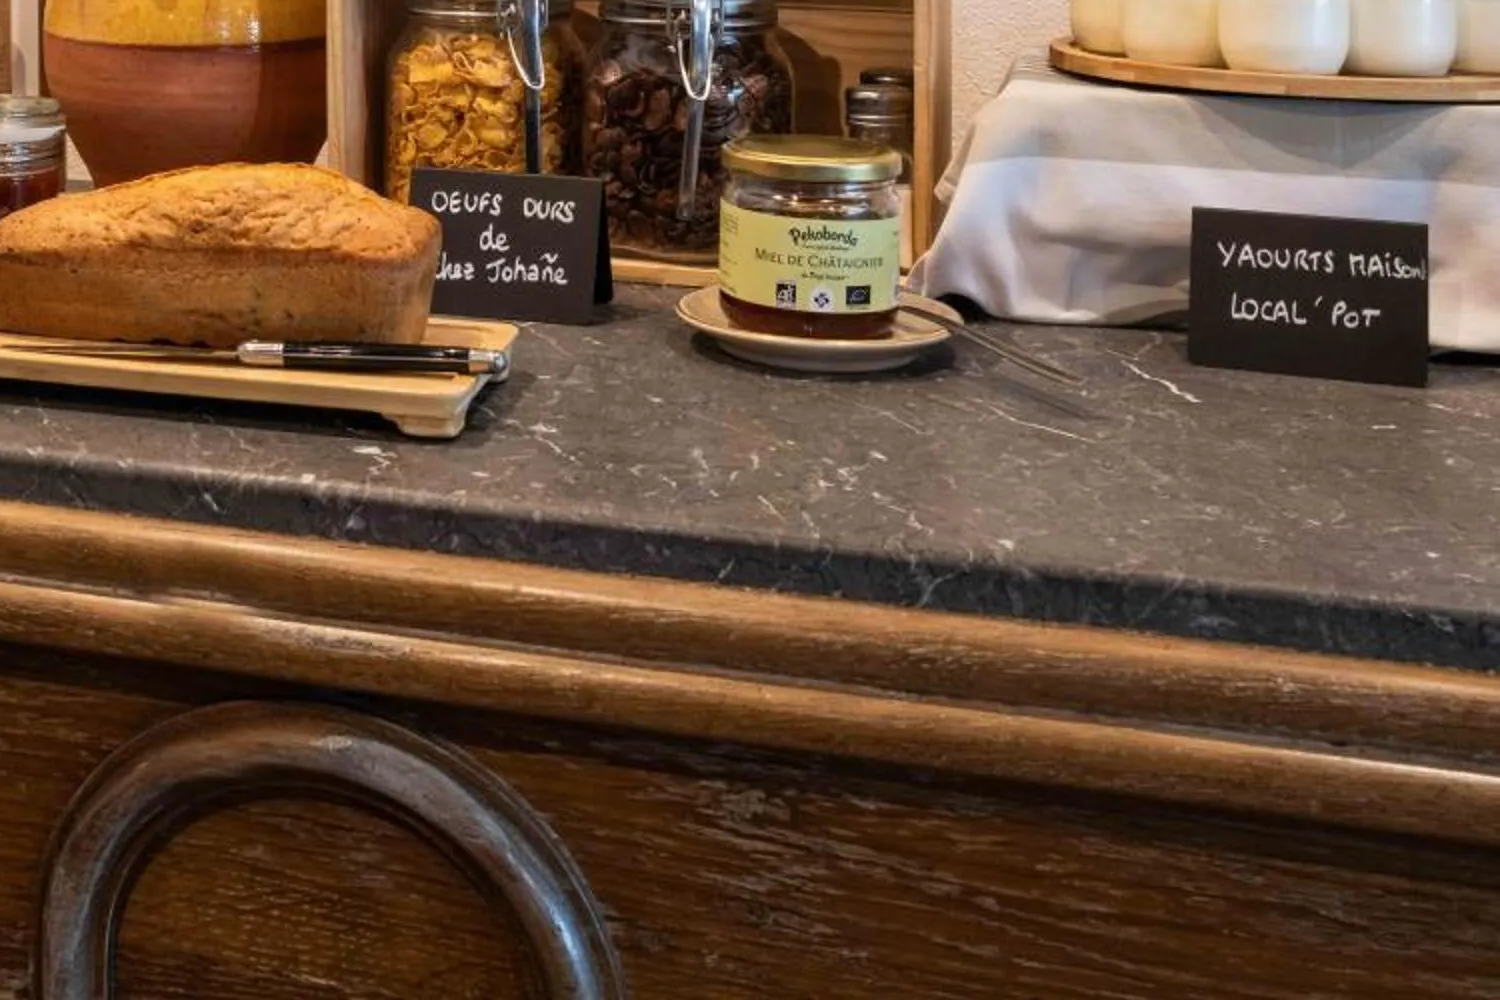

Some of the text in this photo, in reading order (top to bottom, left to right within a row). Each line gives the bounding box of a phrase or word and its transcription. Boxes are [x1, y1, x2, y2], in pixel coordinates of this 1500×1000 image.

[431, 191, 576, 223] OEUFS DURS
[479, 224, 510, 251] de
[787, 255, 804, 266] DE
[1217, 241, 1334, 274] YAOURTS
